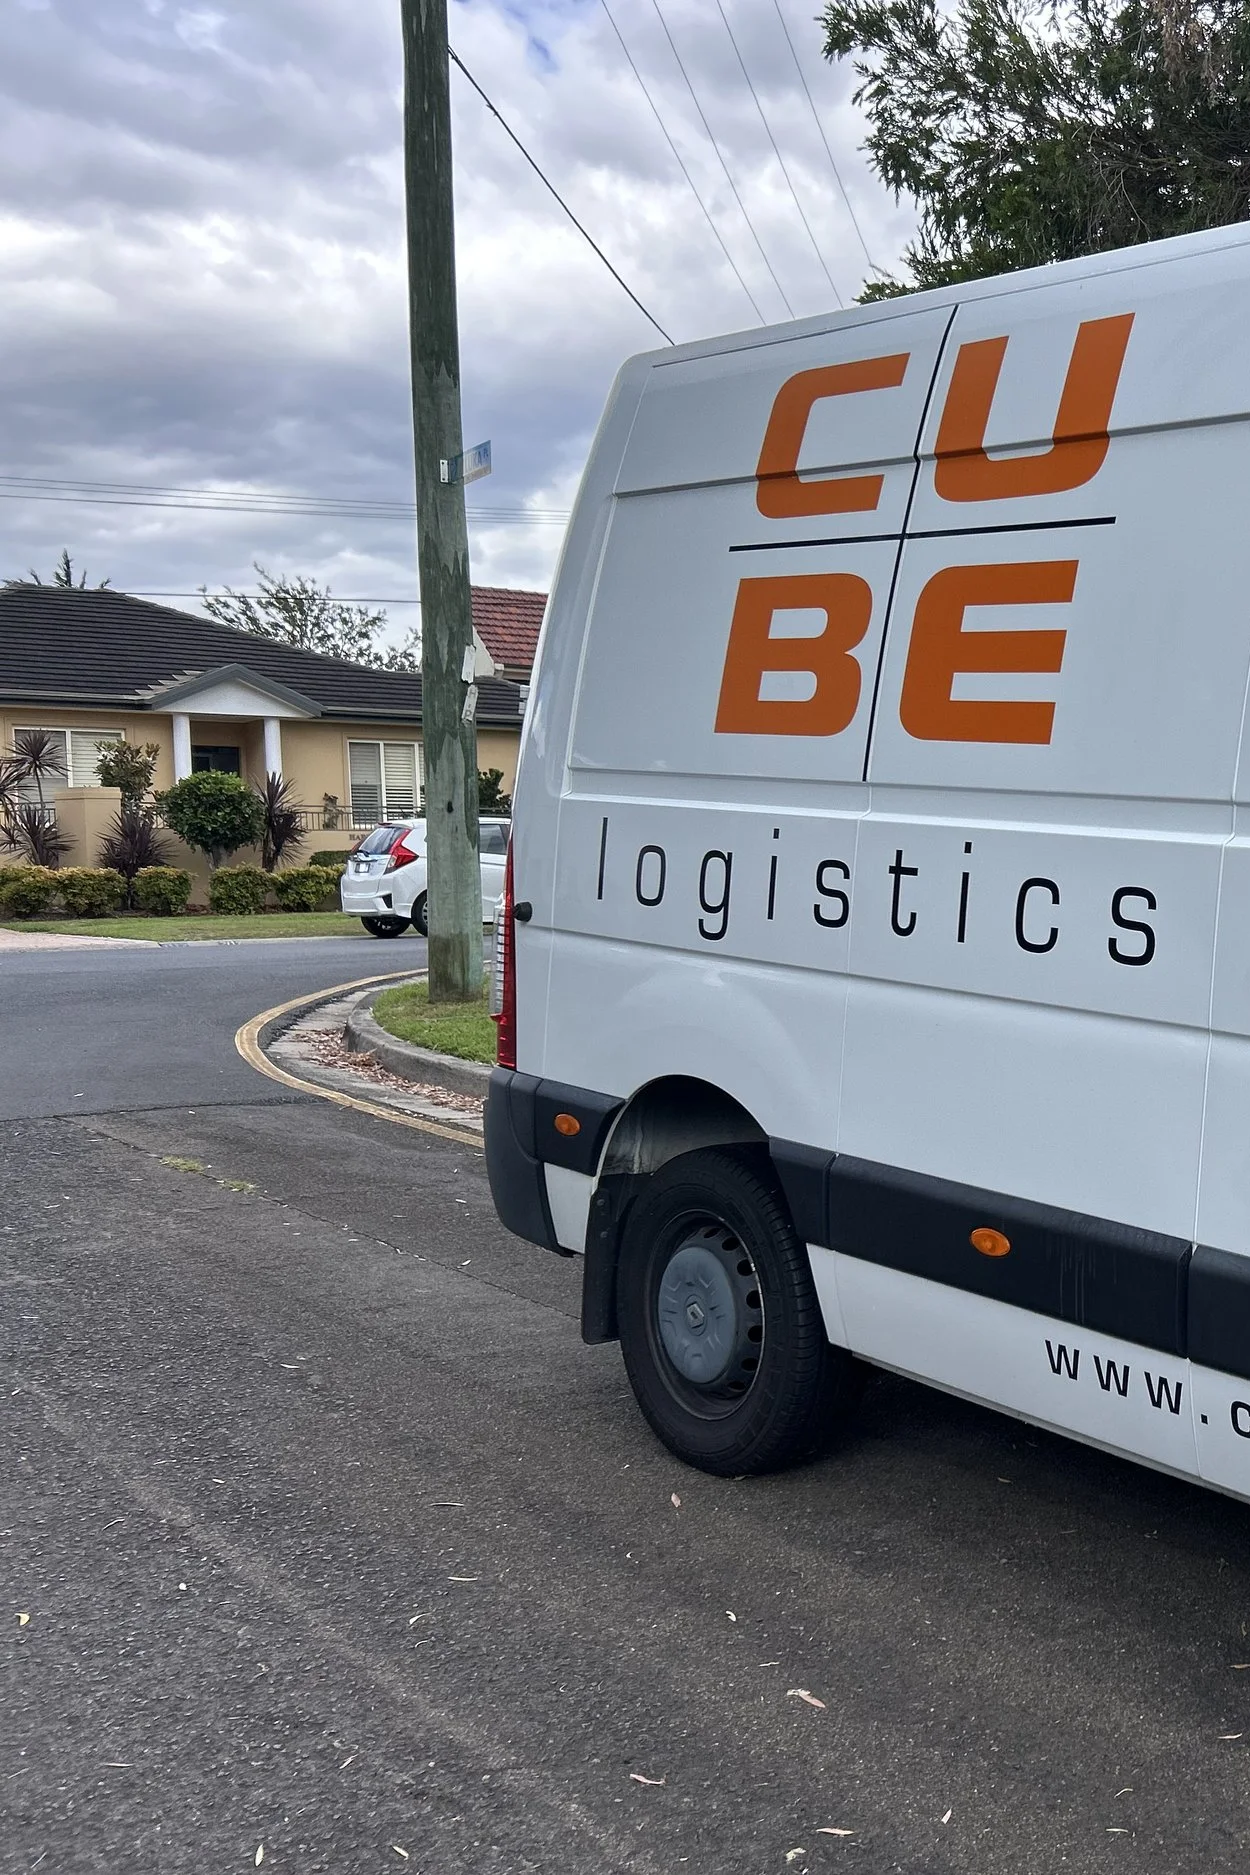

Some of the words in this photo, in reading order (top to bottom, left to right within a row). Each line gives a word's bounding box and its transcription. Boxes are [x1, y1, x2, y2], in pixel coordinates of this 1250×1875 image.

[755, 313, 1135, 518] CU
[714, 559, 1079, 745] BE
[597, 816, 1158, 967] logistics
